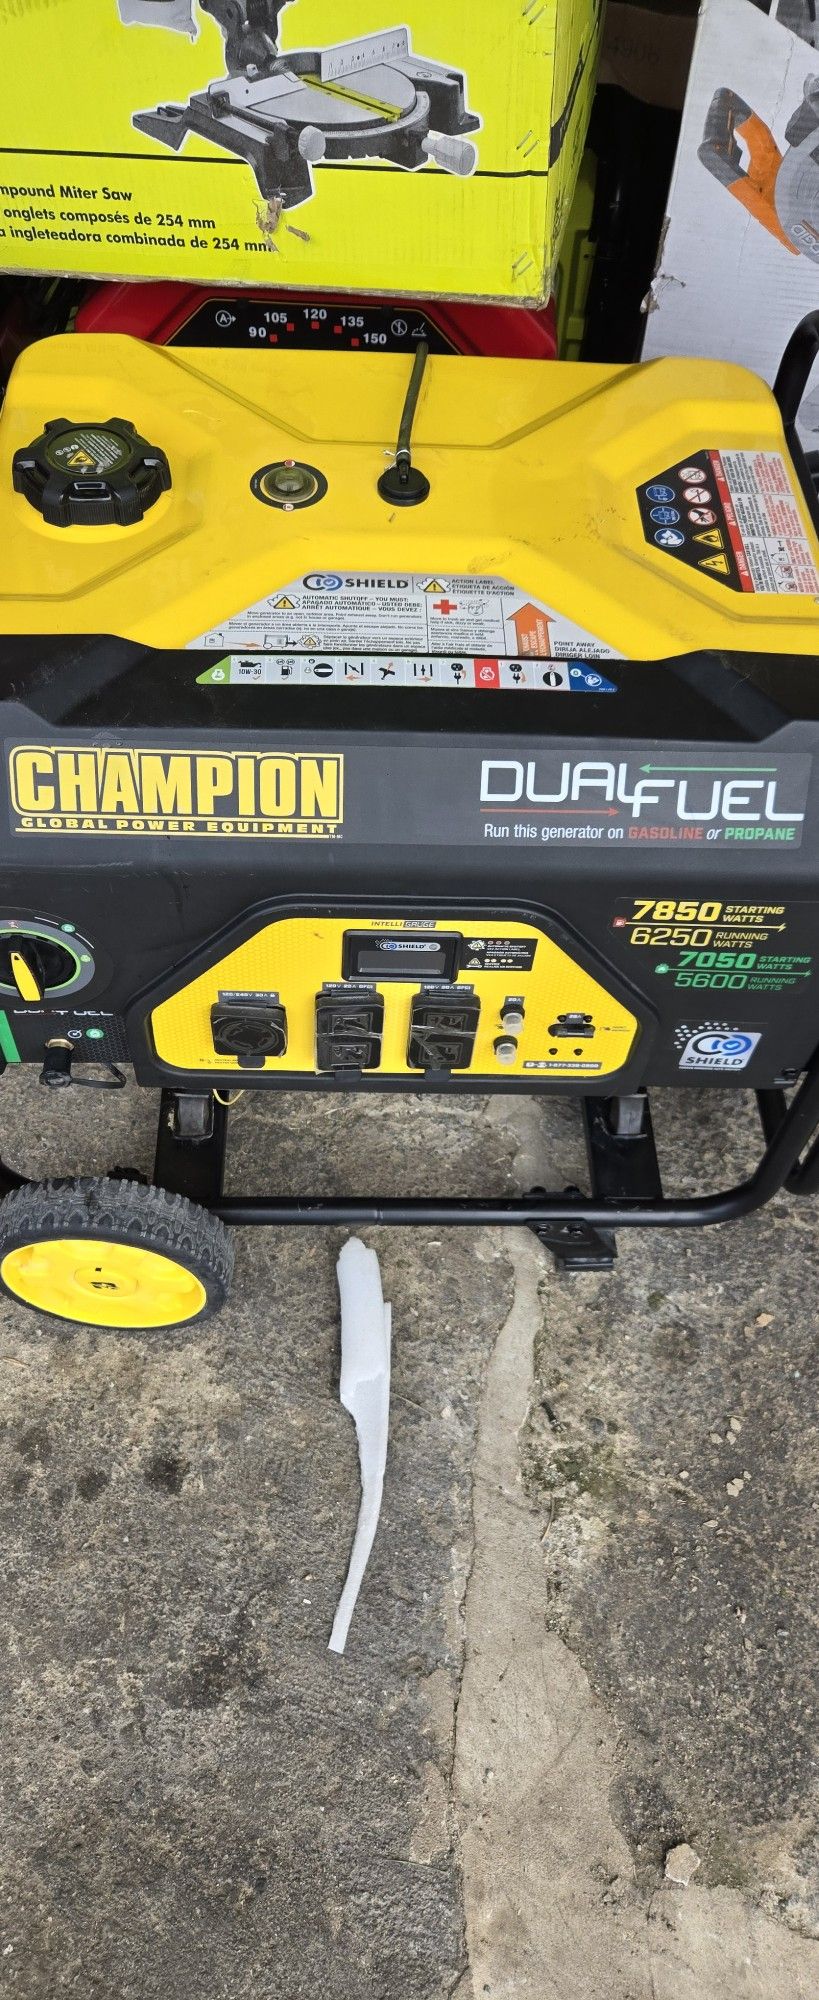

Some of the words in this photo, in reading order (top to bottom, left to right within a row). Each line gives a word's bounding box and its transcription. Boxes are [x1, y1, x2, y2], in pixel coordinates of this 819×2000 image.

[60, 185, 98, 199] Miter
[102, 187, 133, 202] Saw
[3, 206, 56, 222] onglets
[60, 211, 130, 225] composés
[134, 212, 151, 225] de
[156, 213, 184, 227] 254
[188, 218, 216, 229] mm
[9, 226, 102, 242] ingleteadora
[106, 231, 186, 248] combinada
[190, 235, 208, 248] de
[212, 237, 240, 250] 254
[264, 312, 288, 324] 105
[303, 308, 328, 320] 120
[340, 316, 365, 328] 135
[248, 326, 267, 338] 90
[363, 332, 388, 345] 150
[345, 578, 408, 589] SHIELD
[14, 750, 340, 819] CHAMPION
[480, 760, 659, 803] DUAL
[631, 779, 805, 822] FUEL
[21, 817, 105, 830] GLOBAL
[116, 819, 196, 832] POWER
[207, 821, 338, 834] EQUIPMENT
[484, 823, 510, 839] Run
[513, 824, 537, 839] this
[541, 825, 604, 841] generator
[607, 827, 624, 839] on
[628, 826, 703, 841] GASOLINE
[706, 828, 722, 840] or
[724, 827, 796, 841] PROPANE
[631, 900, 723, 922] 7850
[725, 905, 786, 915] STARTING
[722, 914, 764, 923] WATTS
[630, 927, 713, 947] 6250
[715, 931, 769, 941] RUNNING
[713, 940, 753, 949] WATTS
[677, 951, 757, 969] 7050
[758, 955, 813, 964] STARTING
[756, 963, 793, 971] WATTS
[674, 972, 748, 990] 5600
[750, 976, 796, 985] RUNNING
[747, 983, 783, 991] WATTS
[685, 1056, 743, 1066] SHIELD
